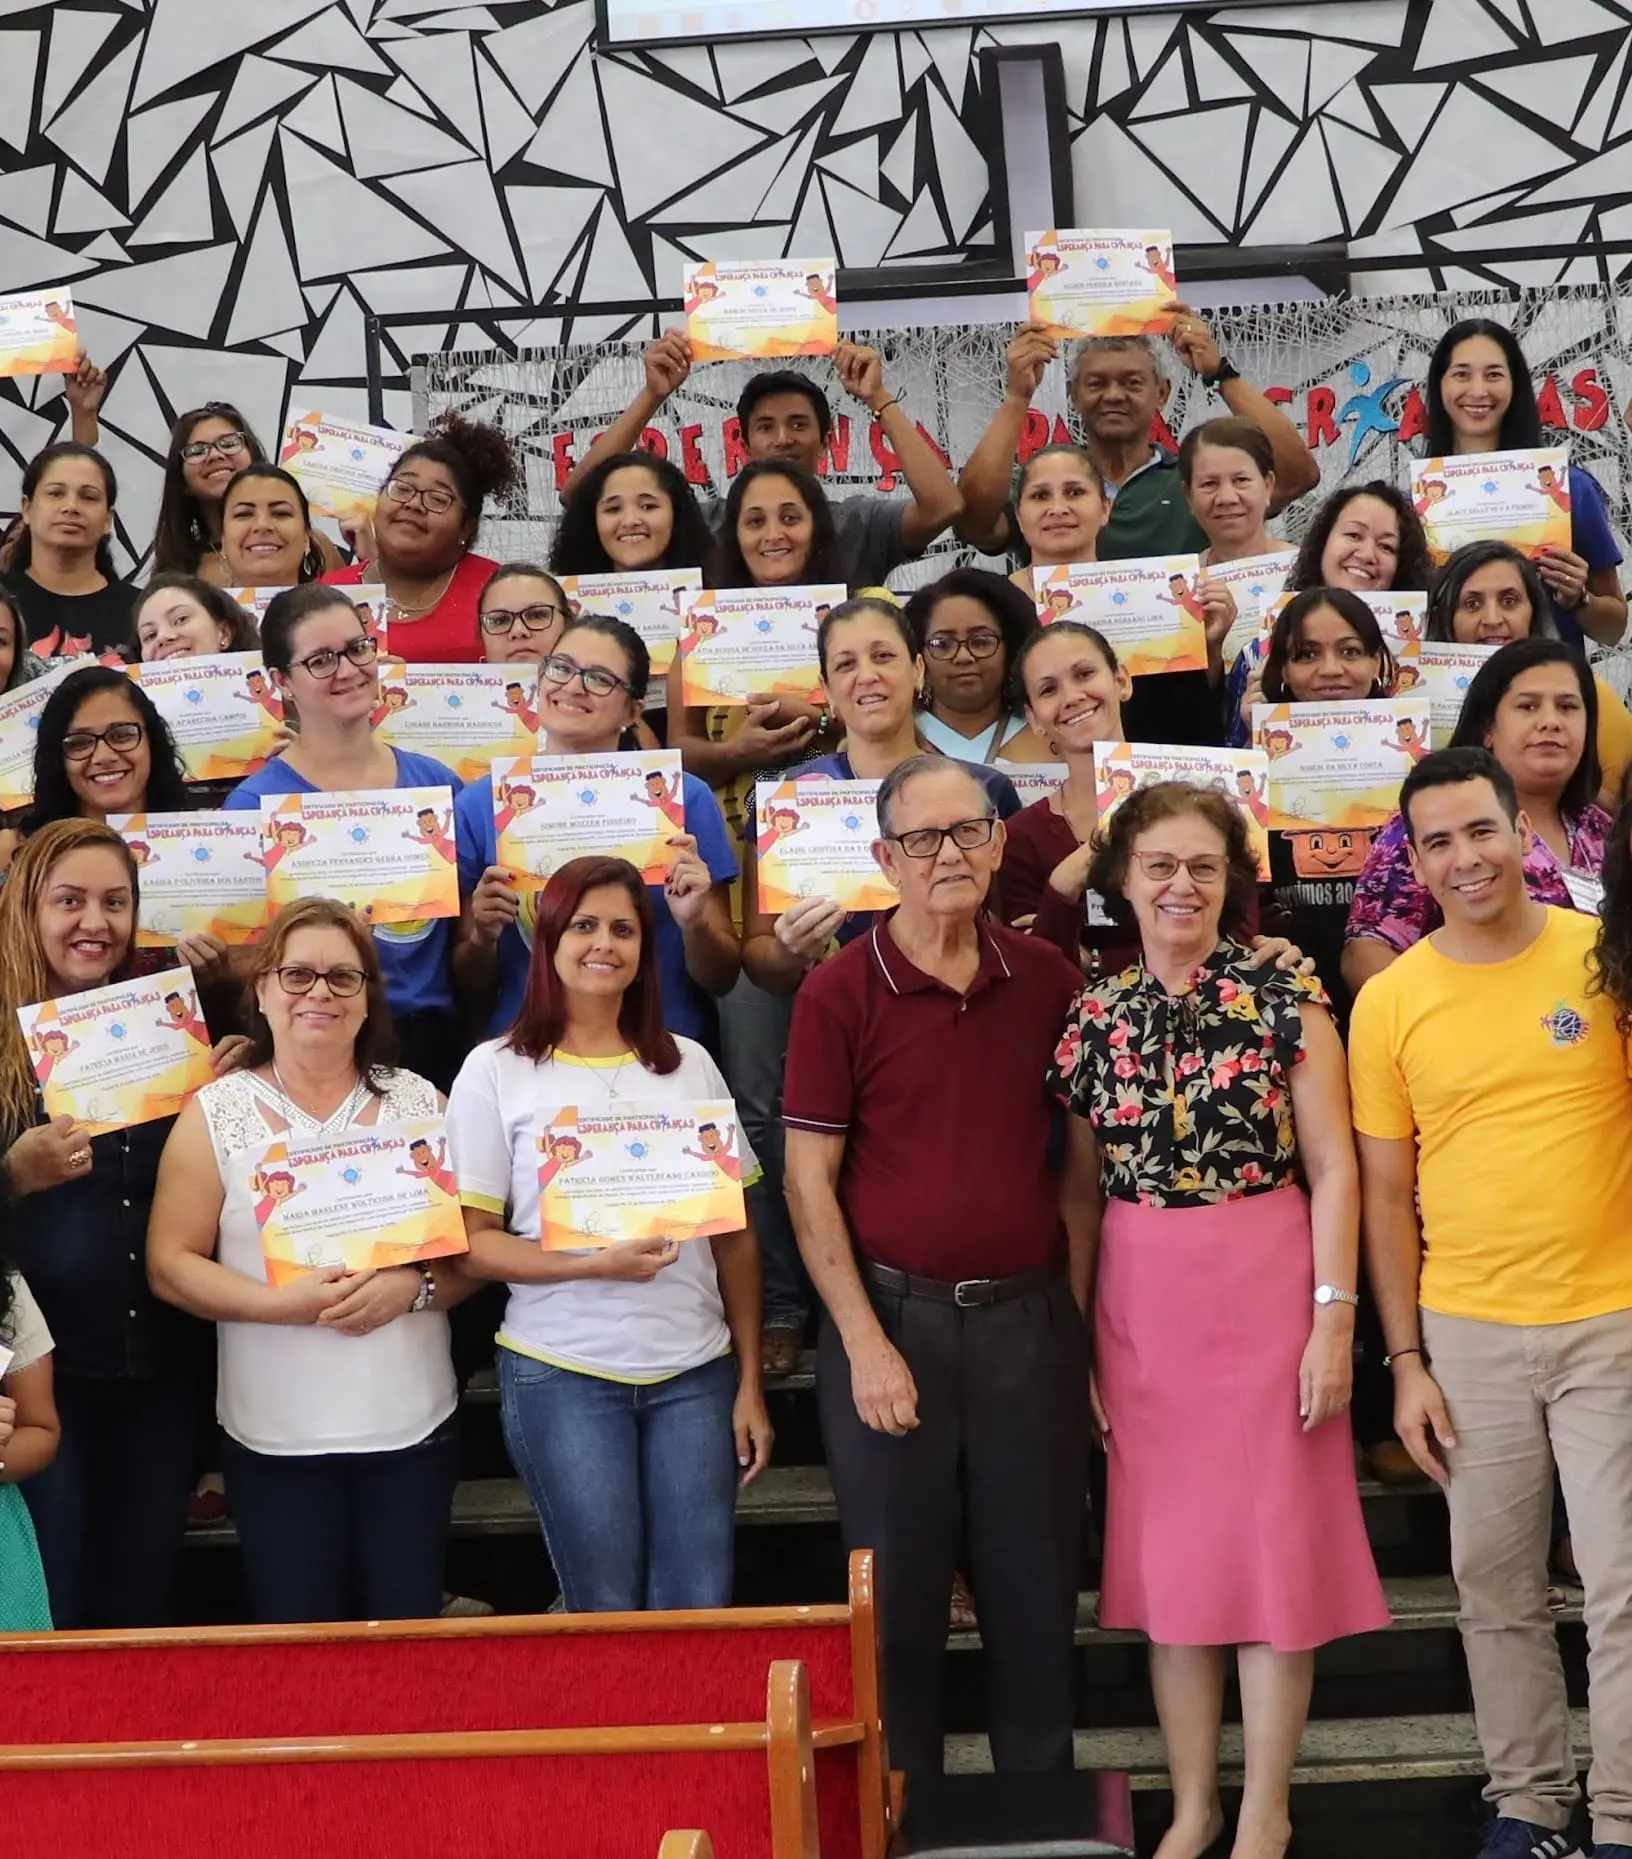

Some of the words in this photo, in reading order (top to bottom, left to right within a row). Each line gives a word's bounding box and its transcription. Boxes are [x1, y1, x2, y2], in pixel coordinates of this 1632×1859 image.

[301, 808, 347, 821] ESPERANÇA
[348, 807, 370, 819] PARA
[146, 828, 191, 840] ESPERANÇA
[192, 827, 214, 838] PARA
[577, 1121, 625, 1135] ESPERANÇA
[626, 1120, 649, 1132] PARA
[288, 1149, 336, 1169] ESPERANÇA
[337, 1145, 360, 1160] PARA
